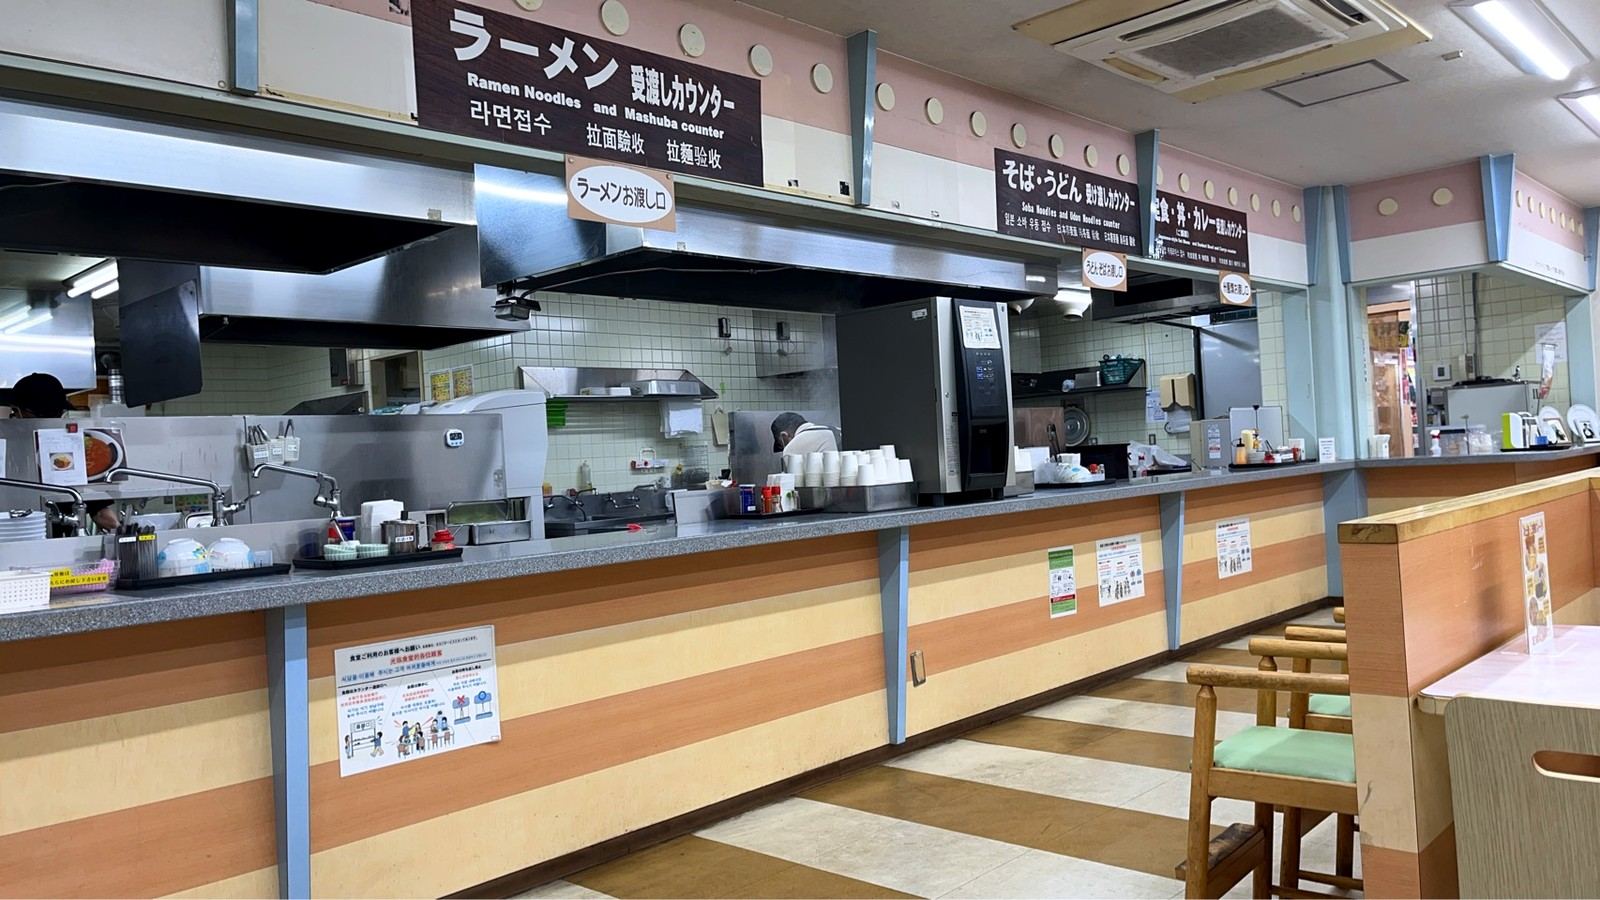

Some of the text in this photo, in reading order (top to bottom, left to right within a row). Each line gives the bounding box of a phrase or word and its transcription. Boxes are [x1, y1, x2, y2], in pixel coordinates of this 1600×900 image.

[450, 8, 735, 120] ラーメン 受渡しカウンター
[467, 72, 725, 140] Ramen Noodles and Mashuba counter
[470, 100, 552, 136] 라면접수
[586, 123, 645, 155] 拉面驗收
[577, 177, 666, 211] ラーメンお渡し口
[1003, 160, 1082, 203] そば・うどん
[1004, 212, 1014, 226] 일본
[1017, 215, 1027, 229] 소바
[1030, 217, 1039, 231] 우동
[1022, 201, 1034, 213] Soba
[1036, 204, 1057, 218] Noodles
[1059, 211, 1068, 220] and
[1082, 213, 1101, 226] Noodles
[1103, 219, 1120, 229] counter
